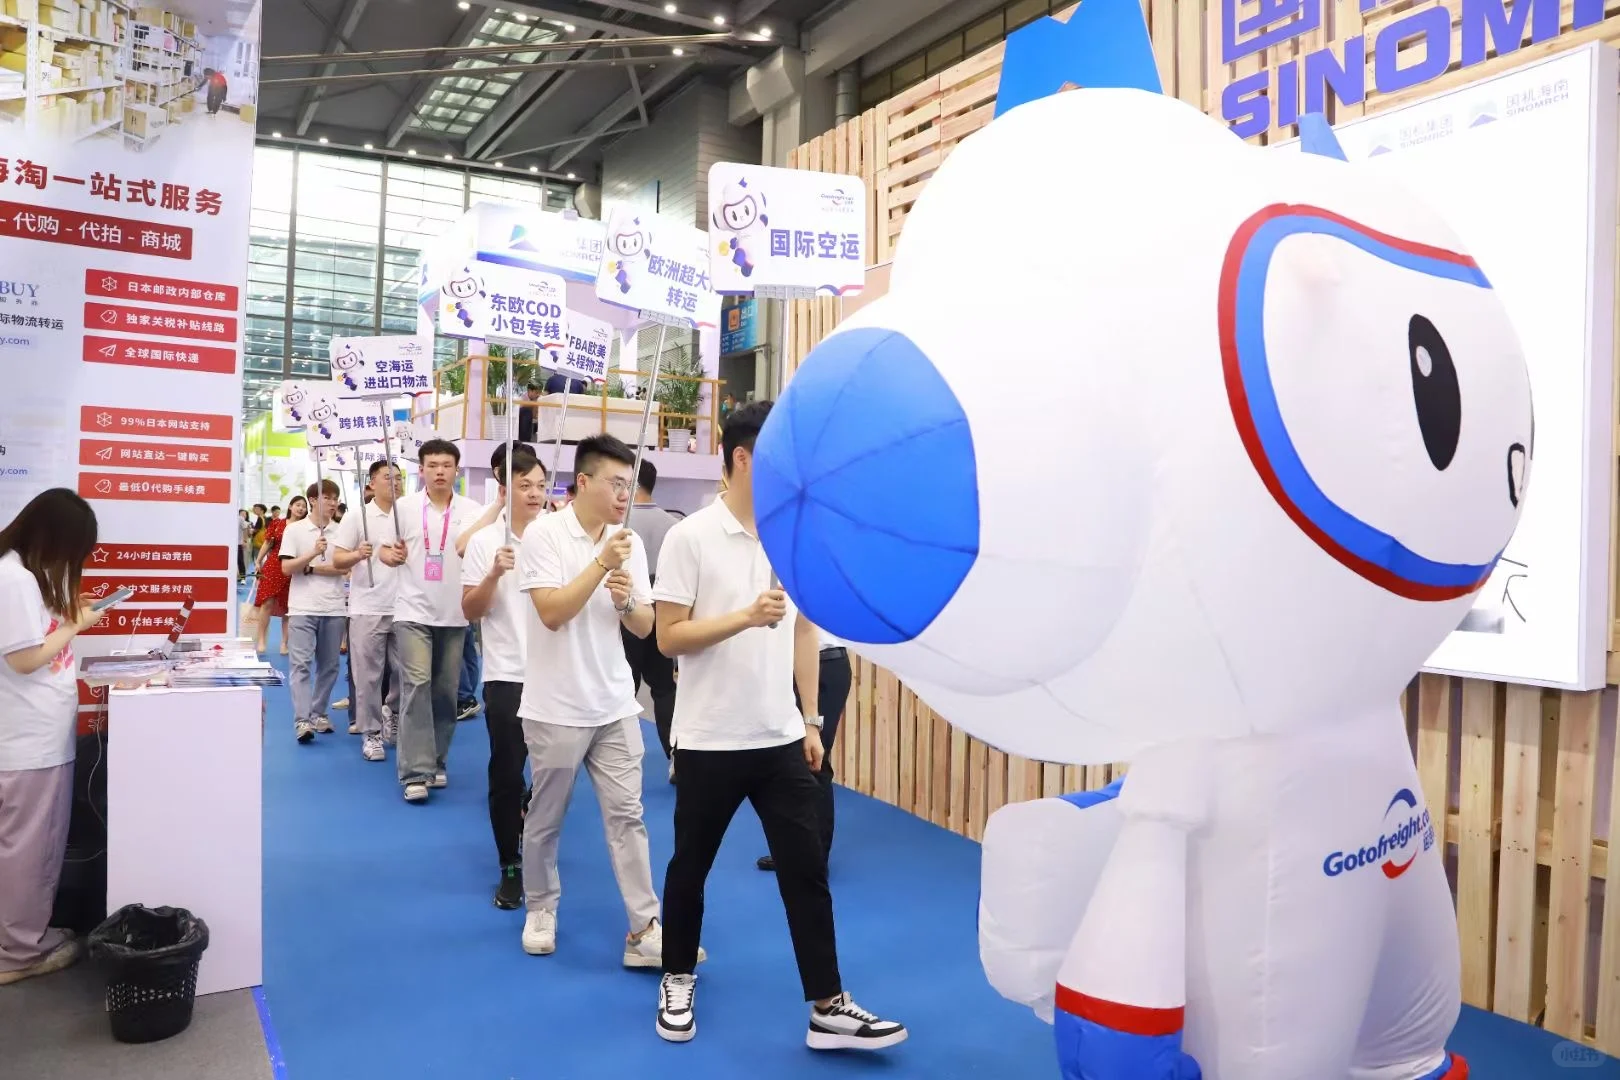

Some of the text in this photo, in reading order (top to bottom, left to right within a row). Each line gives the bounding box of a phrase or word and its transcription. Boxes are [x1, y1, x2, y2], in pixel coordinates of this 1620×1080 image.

[1222, 0, 1605, 140] SINOM
[13, 212, 182, 251] 代购 代拍 商城
[770, 228, 860, 260] 国际空运
[648, 254, 713, 294] 欧洲超大
[127, 281, 226, 302] 日本邮政内部仓库
[666, 286, 698, 313] 转运
[490, 293, 561, 319] 东欧COD
[126, 312, 225, 333] 独家关税补贴线路
[491, 314, 561, 341] 小包专线
[124, 346, 200, 364] 全球国际快递
[569, 336, 607, 360] FBA欧美
[375, 359, 414, 373] 空海运
[566, 352, 605, 376] 头程物流
[364, 375, 429, 390] 进出口物流
[120, 416, 211, 432] 99%日本网站支持
[120, 448, 210, 463] 网站直达一键购买
[118, 481, 206, 495] 最低0代购手续费
[116, 551, 193, 561] 24小时自动竞拍
